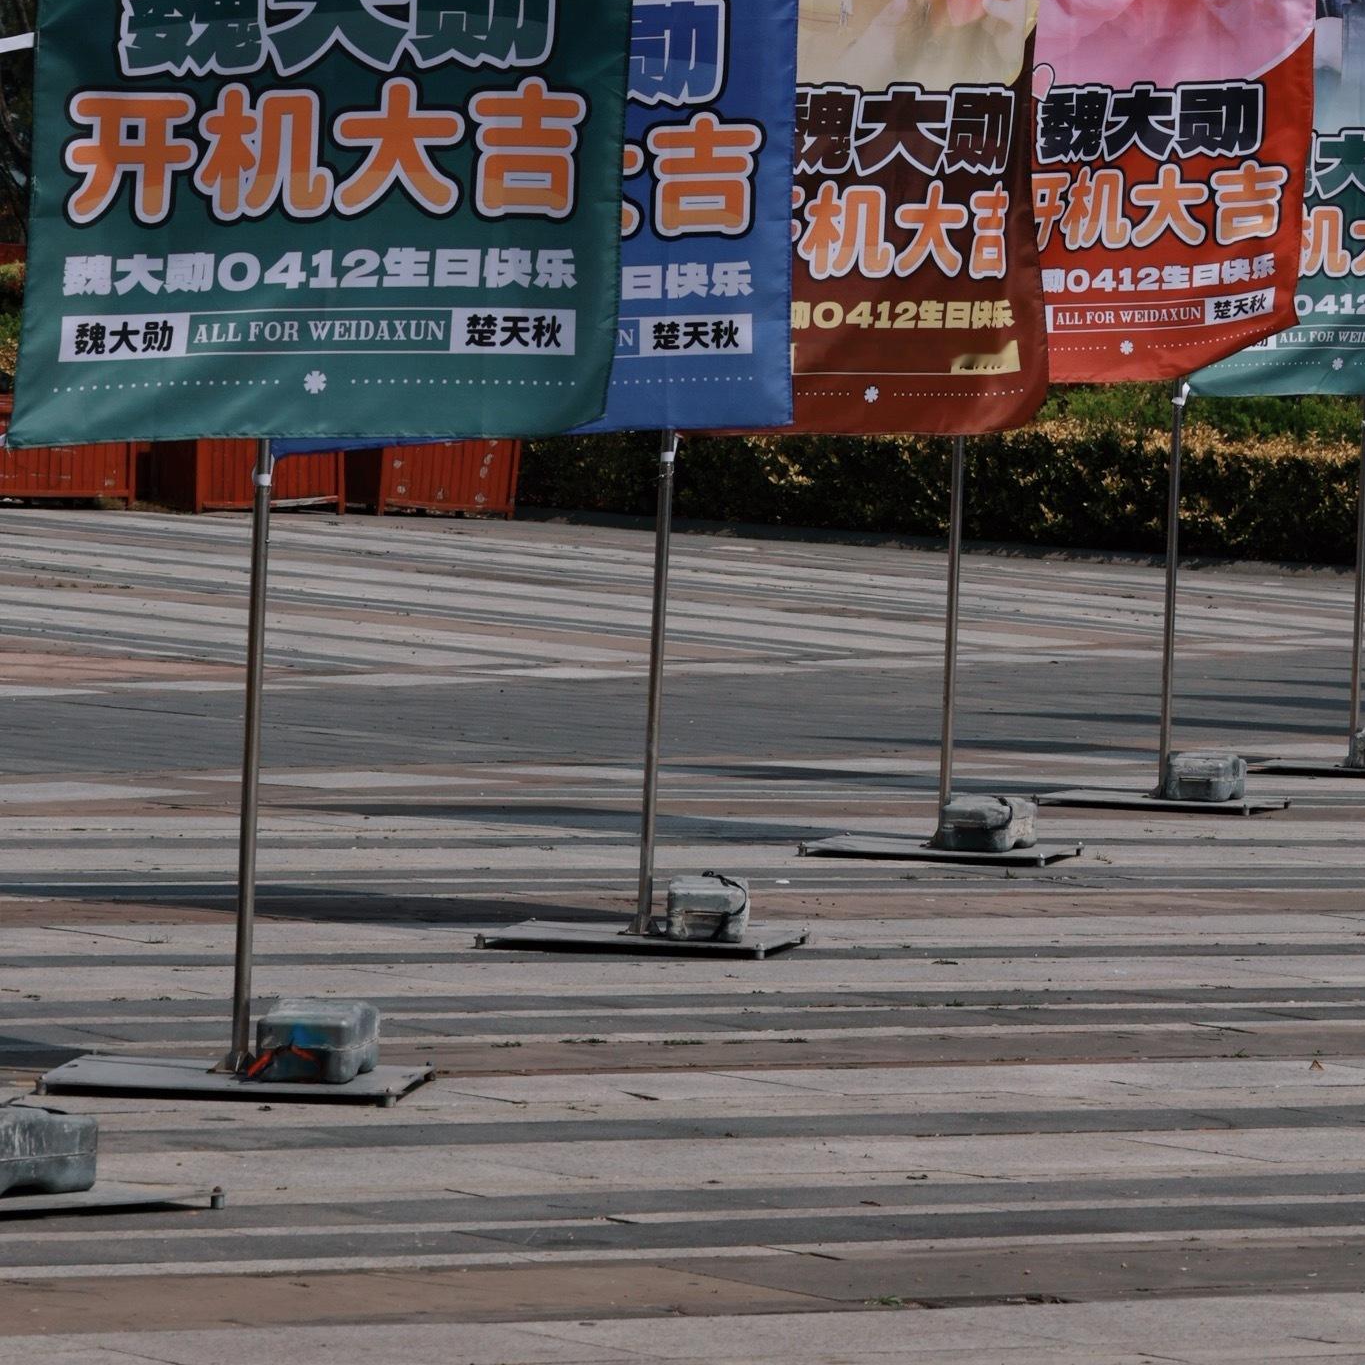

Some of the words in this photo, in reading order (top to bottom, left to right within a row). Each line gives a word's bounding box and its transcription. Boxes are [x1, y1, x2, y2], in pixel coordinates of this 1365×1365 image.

[1036, 82, 1264, 164] 魏大勋
[64, 77, 588, 226] 开机大吉
[793, 180, 1011, 280] 机大吉
[63, 247, 577, 297] 魏大勋0412生日快乐
[1055, 311, 1083, 326] ALL
[1086, 310, 1116, 325] FOR
[1120, 306, 1201, 323] WEIDAXUN
[1213, 293, 1267, 320] 楚天秋
[74, 320, 173, 355] 魏大勋
[193, 322, 241, 344] ALL
[249, 320, 300, 343] FOR
[309, 318, 446, 344] WEIDAXUN
[465, 315, 563, 349] 楚天秋
[651, 319, 740, 350] 楚天秋
[1280, 330, 1306, 343] ALL
[1309, 331, 1334, 343] FOR
